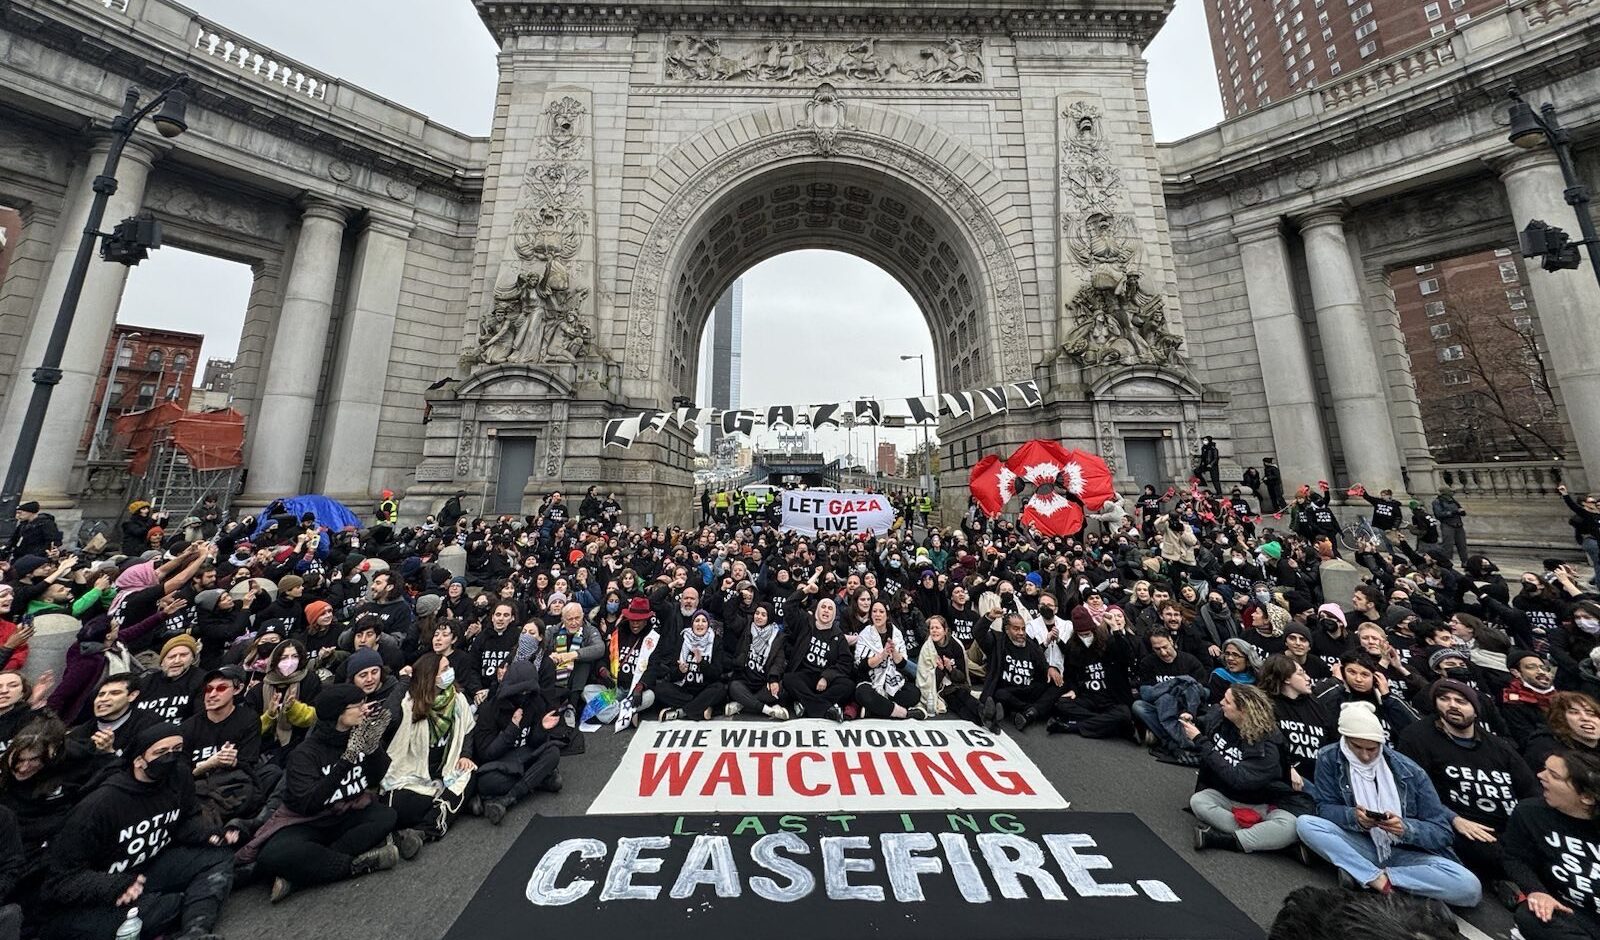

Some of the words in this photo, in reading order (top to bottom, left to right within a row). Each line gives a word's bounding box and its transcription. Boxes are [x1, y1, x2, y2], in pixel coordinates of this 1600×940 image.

[788, 497, 824, 514] LET
[828, 499, 882, 515] GAZA
[813, 516, 858, 531] LIVE
[806, 653, 828, 667] OW
[137, 697, 168, 710] NOT
[171, 695, 189, 706] IN
[1280, 720, 1304, 733] NOT
[1309, 724, 1324, 737] IN
[652, 729, 712, 748] THE
[720, 729, 829, 748] WHOLE
[838, 729, 949, 748] WORLD
[960, 729, 995, 748] IS
[1289, 732, 1320, 749] OUR
[638, 750, 1038, 797] WATCHING
[1445, 765, 1512, 785] CEASE
[323, 775, 369, 805] AME
[1460, 781, 1512, 799] FIRE
[119, 813, 164, 843] NOT
[164, 808, 180, 824] IN
[672, 813, 1027, 834] LASTING
[525, 831, 1182, 906] CEASEFIRE.
